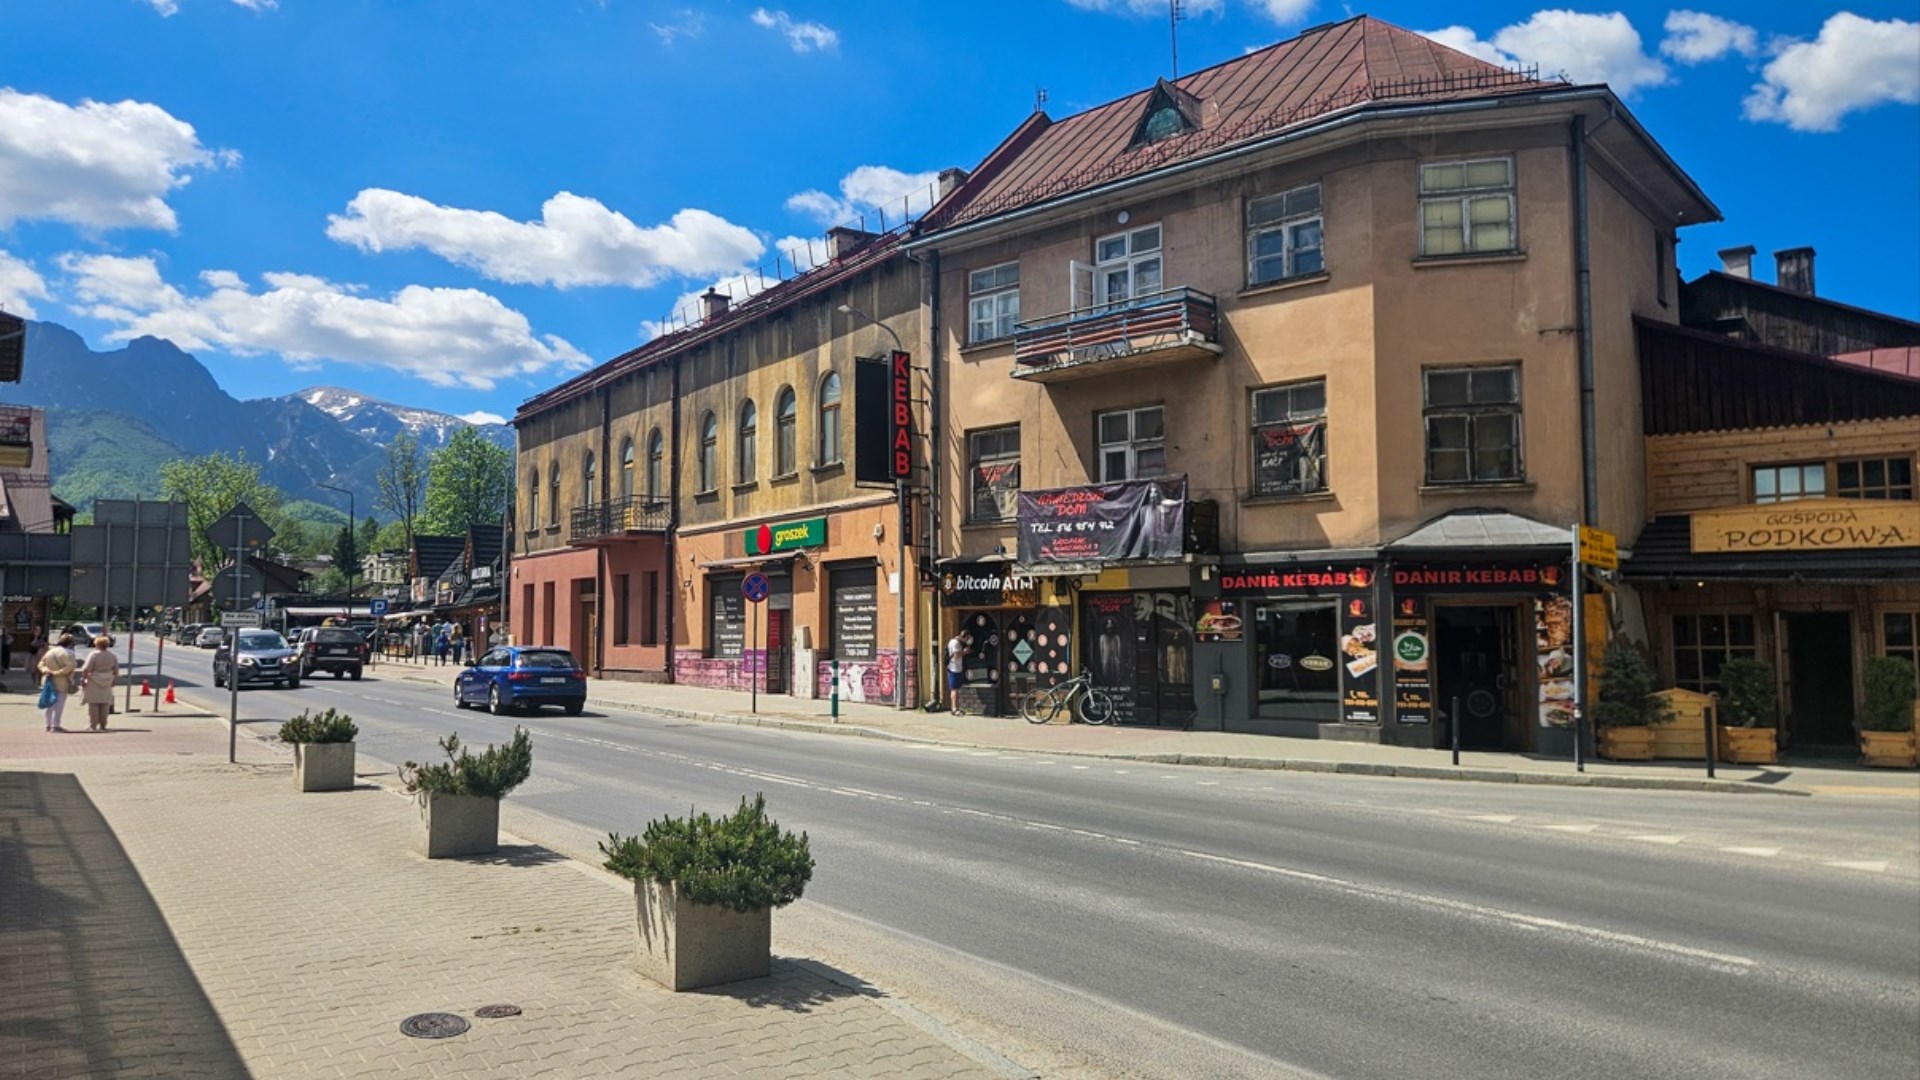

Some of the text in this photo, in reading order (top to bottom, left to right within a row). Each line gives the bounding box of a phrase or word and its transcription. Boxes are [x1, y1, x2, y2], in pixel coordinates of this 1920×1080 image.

[893, 354, 909, 474] KEBAB
[1056, 503, 1088, 516] DOM
[1766, 509, 1858, 526] GOSPODA
[775, 523, 809, 547] groszek
[1724, 525, 1905, 547] PODKOWA
[956, 573, 1034, 591] bitcoin ATM
[1222, 572, 1347, 589] DANIR KEBAB
[1394, 569, 1537, 585] DANIR KEBAB
